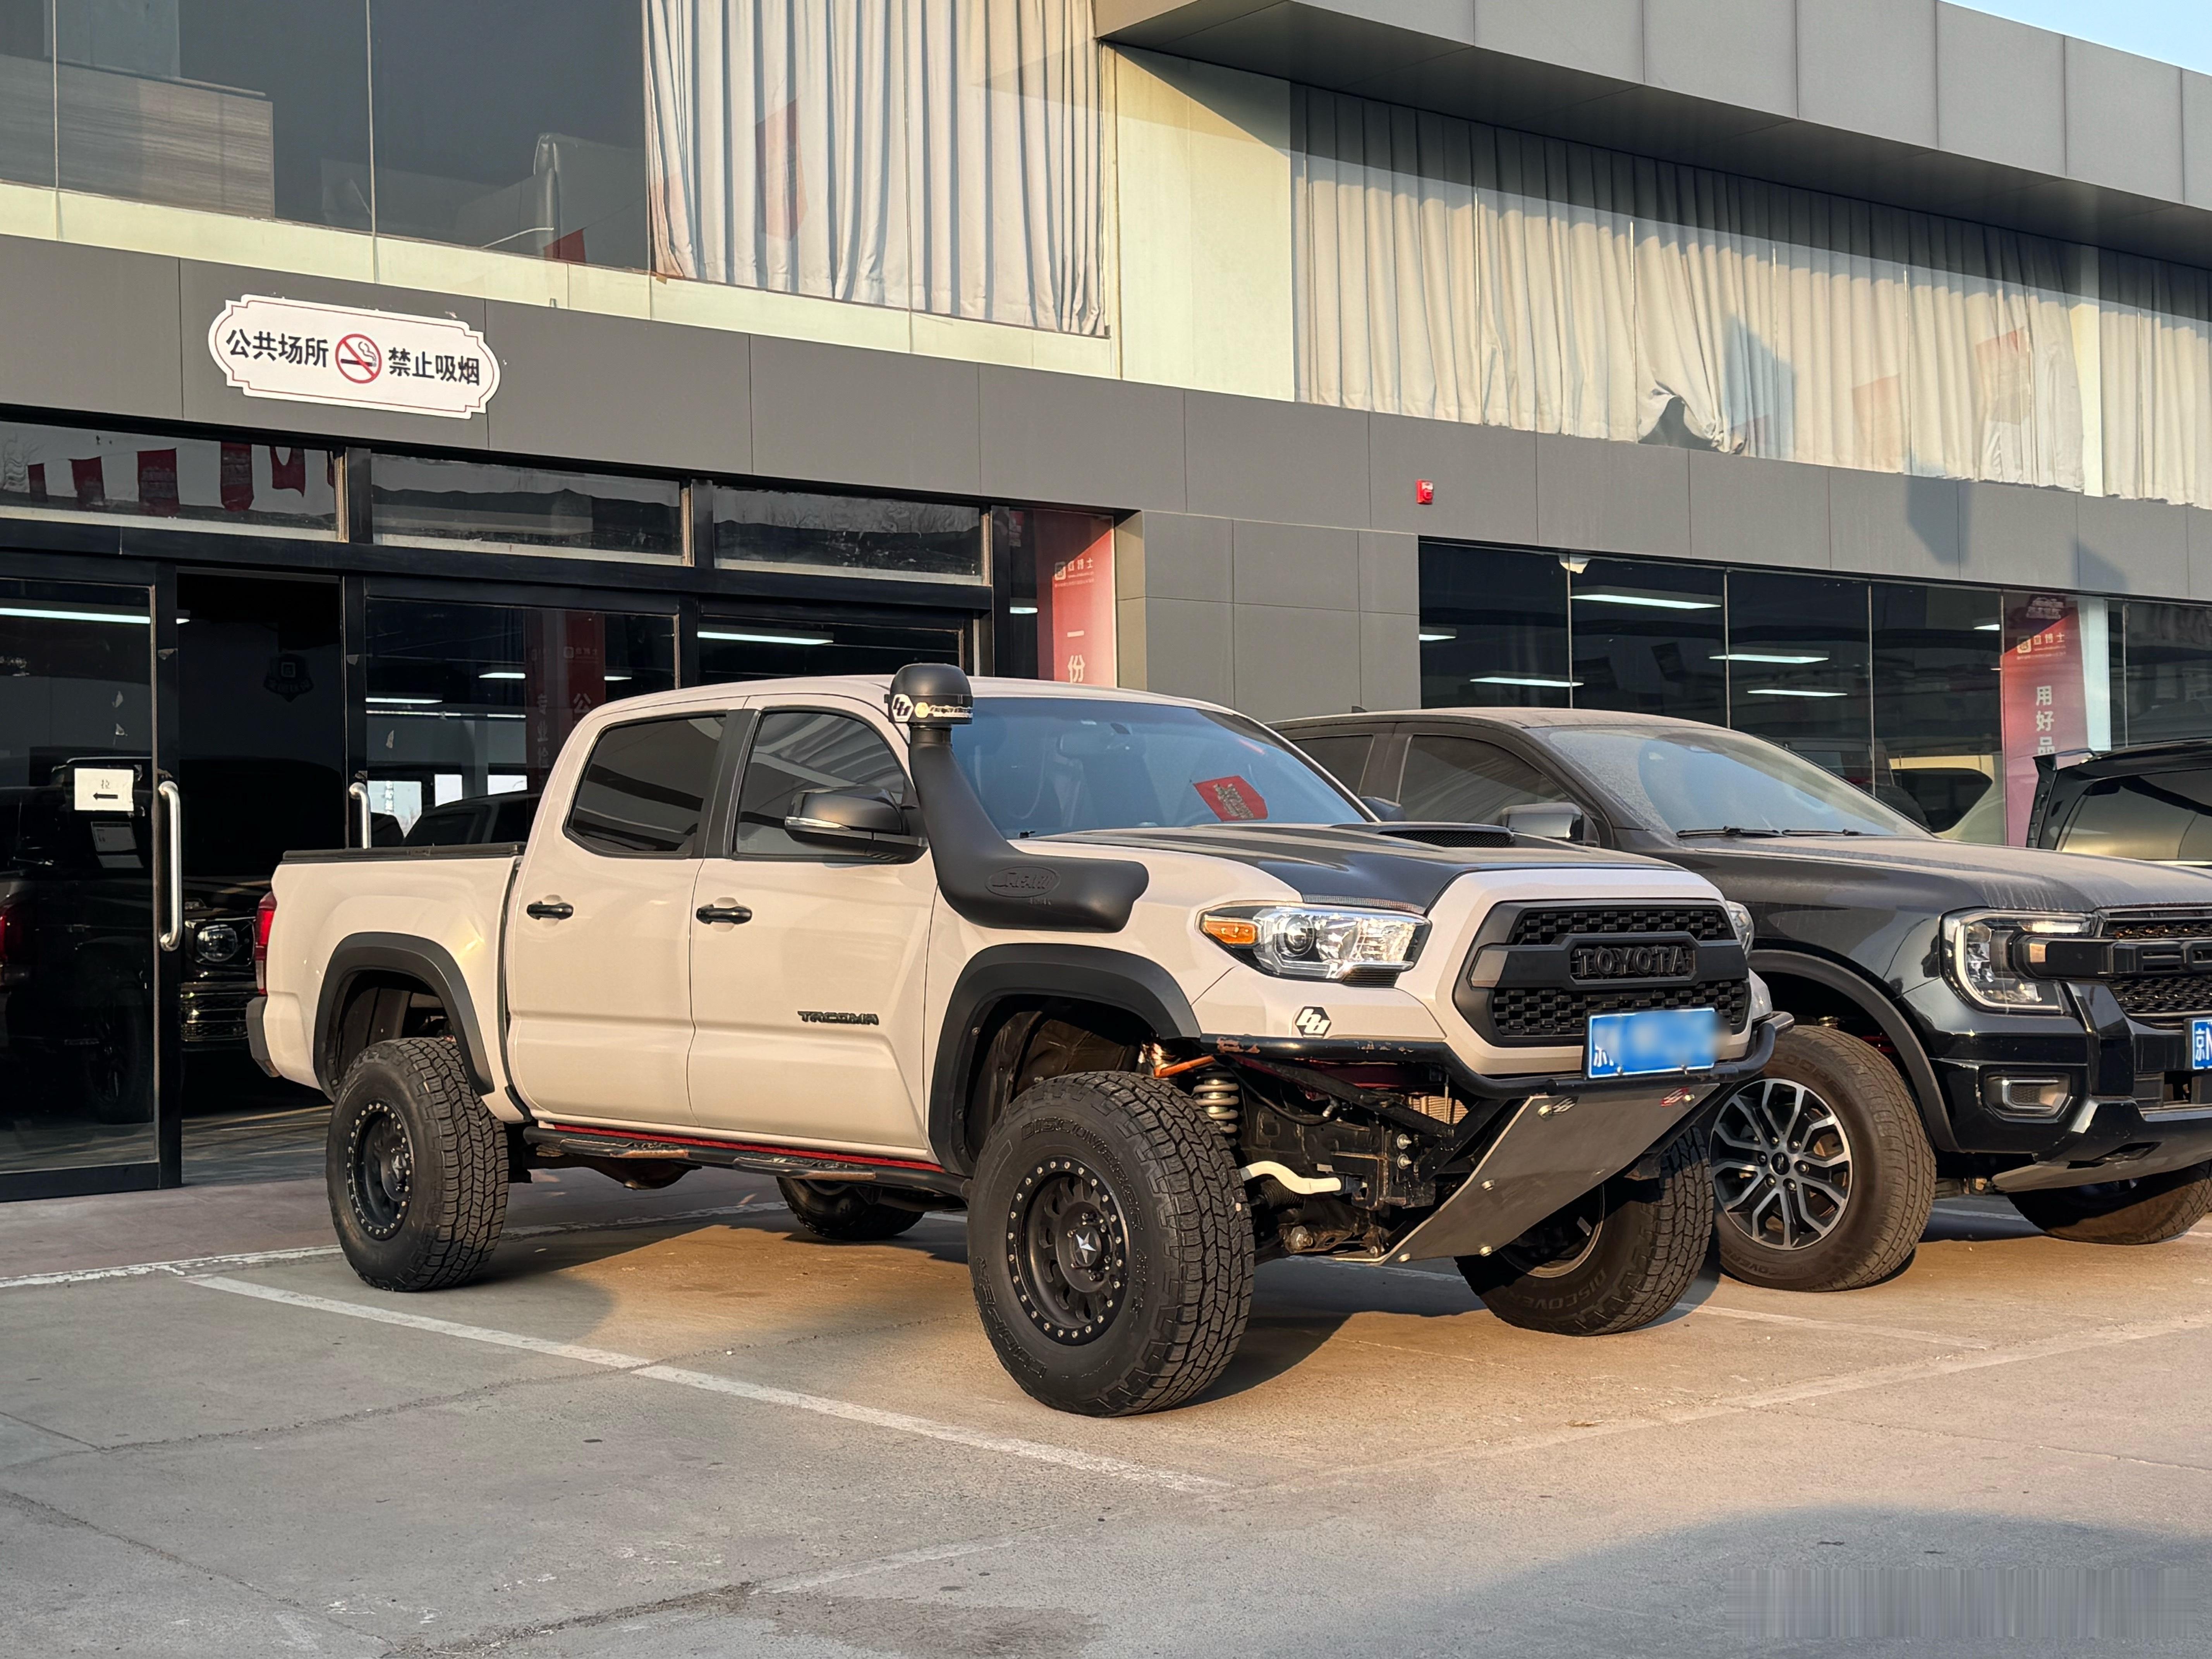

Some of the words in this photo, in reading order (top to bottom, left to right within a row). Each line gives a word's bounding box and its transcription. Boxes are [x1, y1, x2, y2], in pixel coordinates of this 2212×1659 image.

[227, 329, 328, 368] 公共场所
[388, 347, 480, 386] 禁止吸烟
[2036, 685, 2055, 755] 用好品
[1573, 946, 1685, 977] TOYOTA
[797, 1010, 879, 1026] TACOMA
